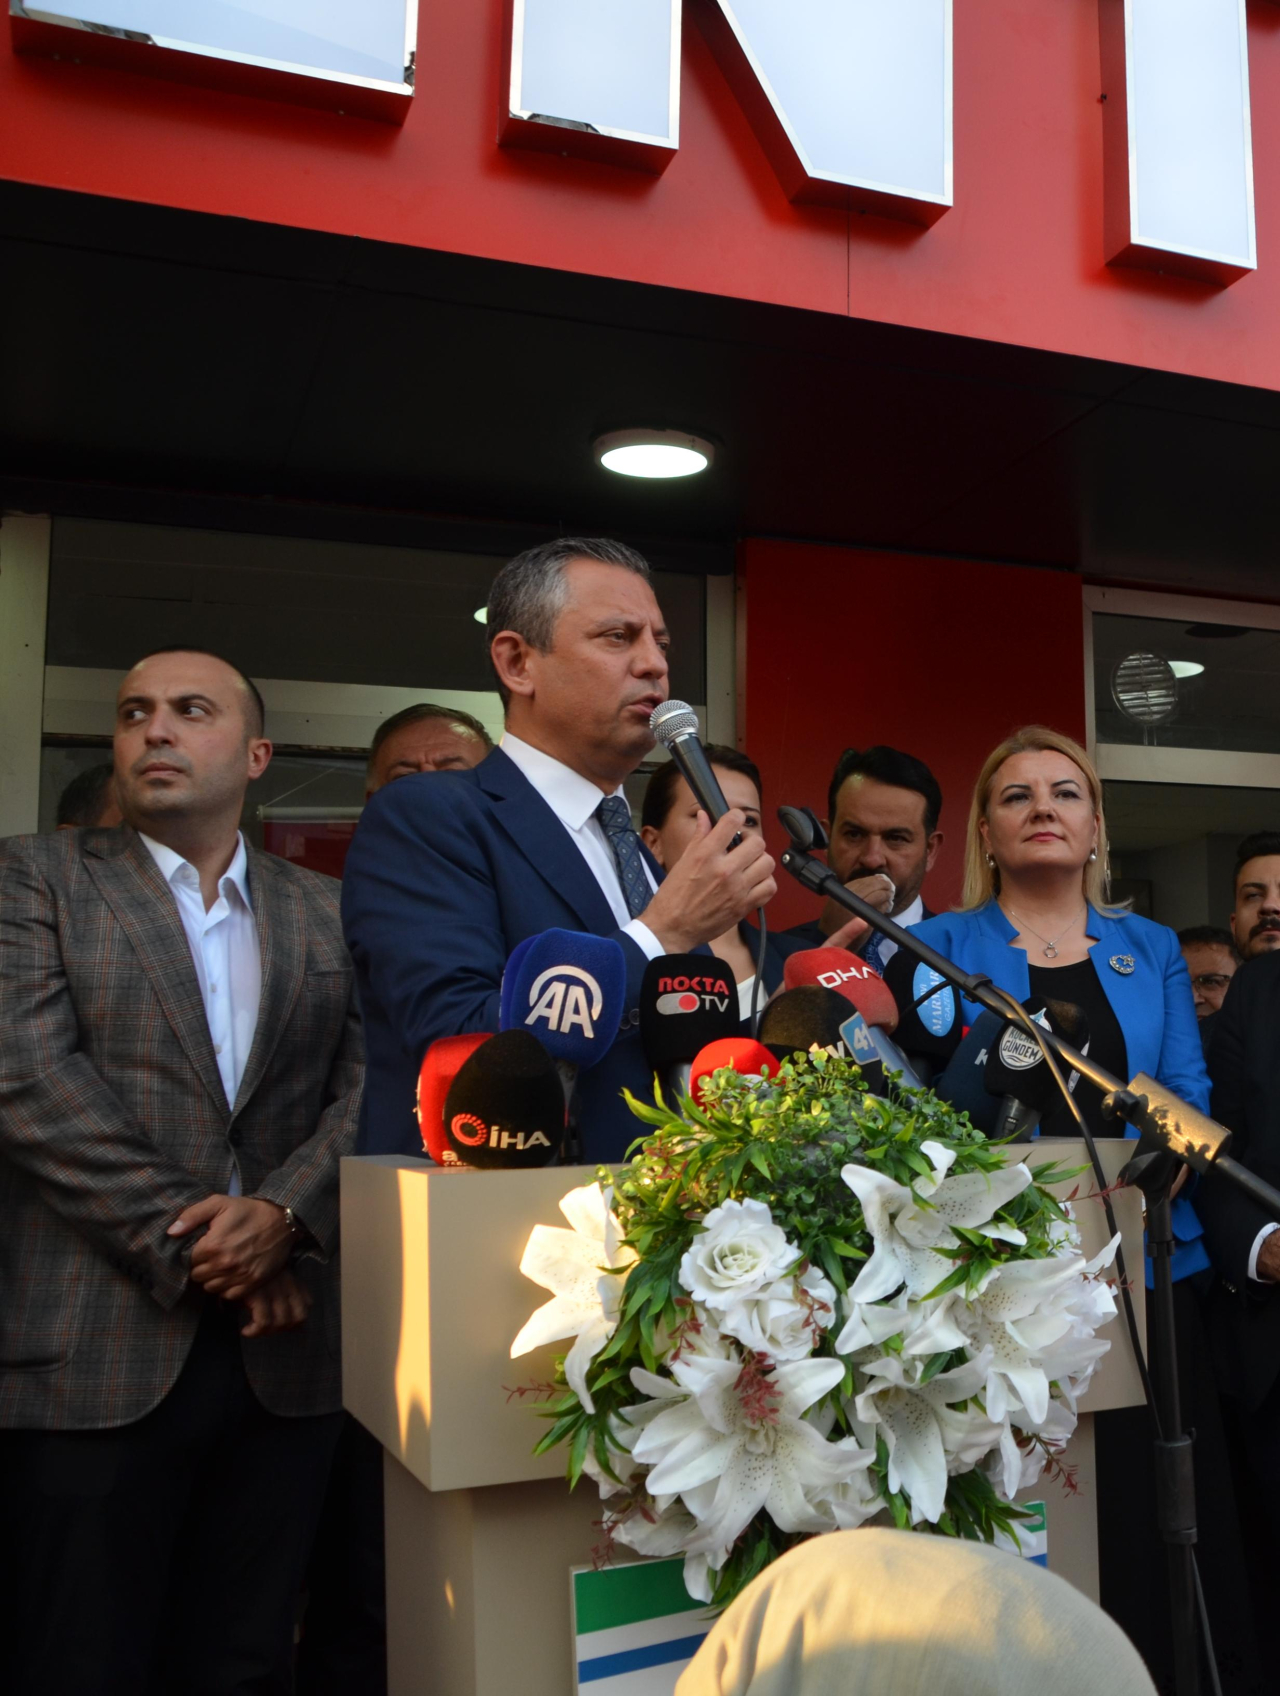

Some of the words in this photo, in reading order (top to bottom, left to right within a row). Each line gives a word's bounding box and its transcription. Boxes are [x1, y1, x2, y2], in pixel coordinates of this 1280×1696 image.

[524, 981, 595, 1039] AA
[700, 994, 730, 1013] TV
[489, 1125, 551, 1150] İHA
